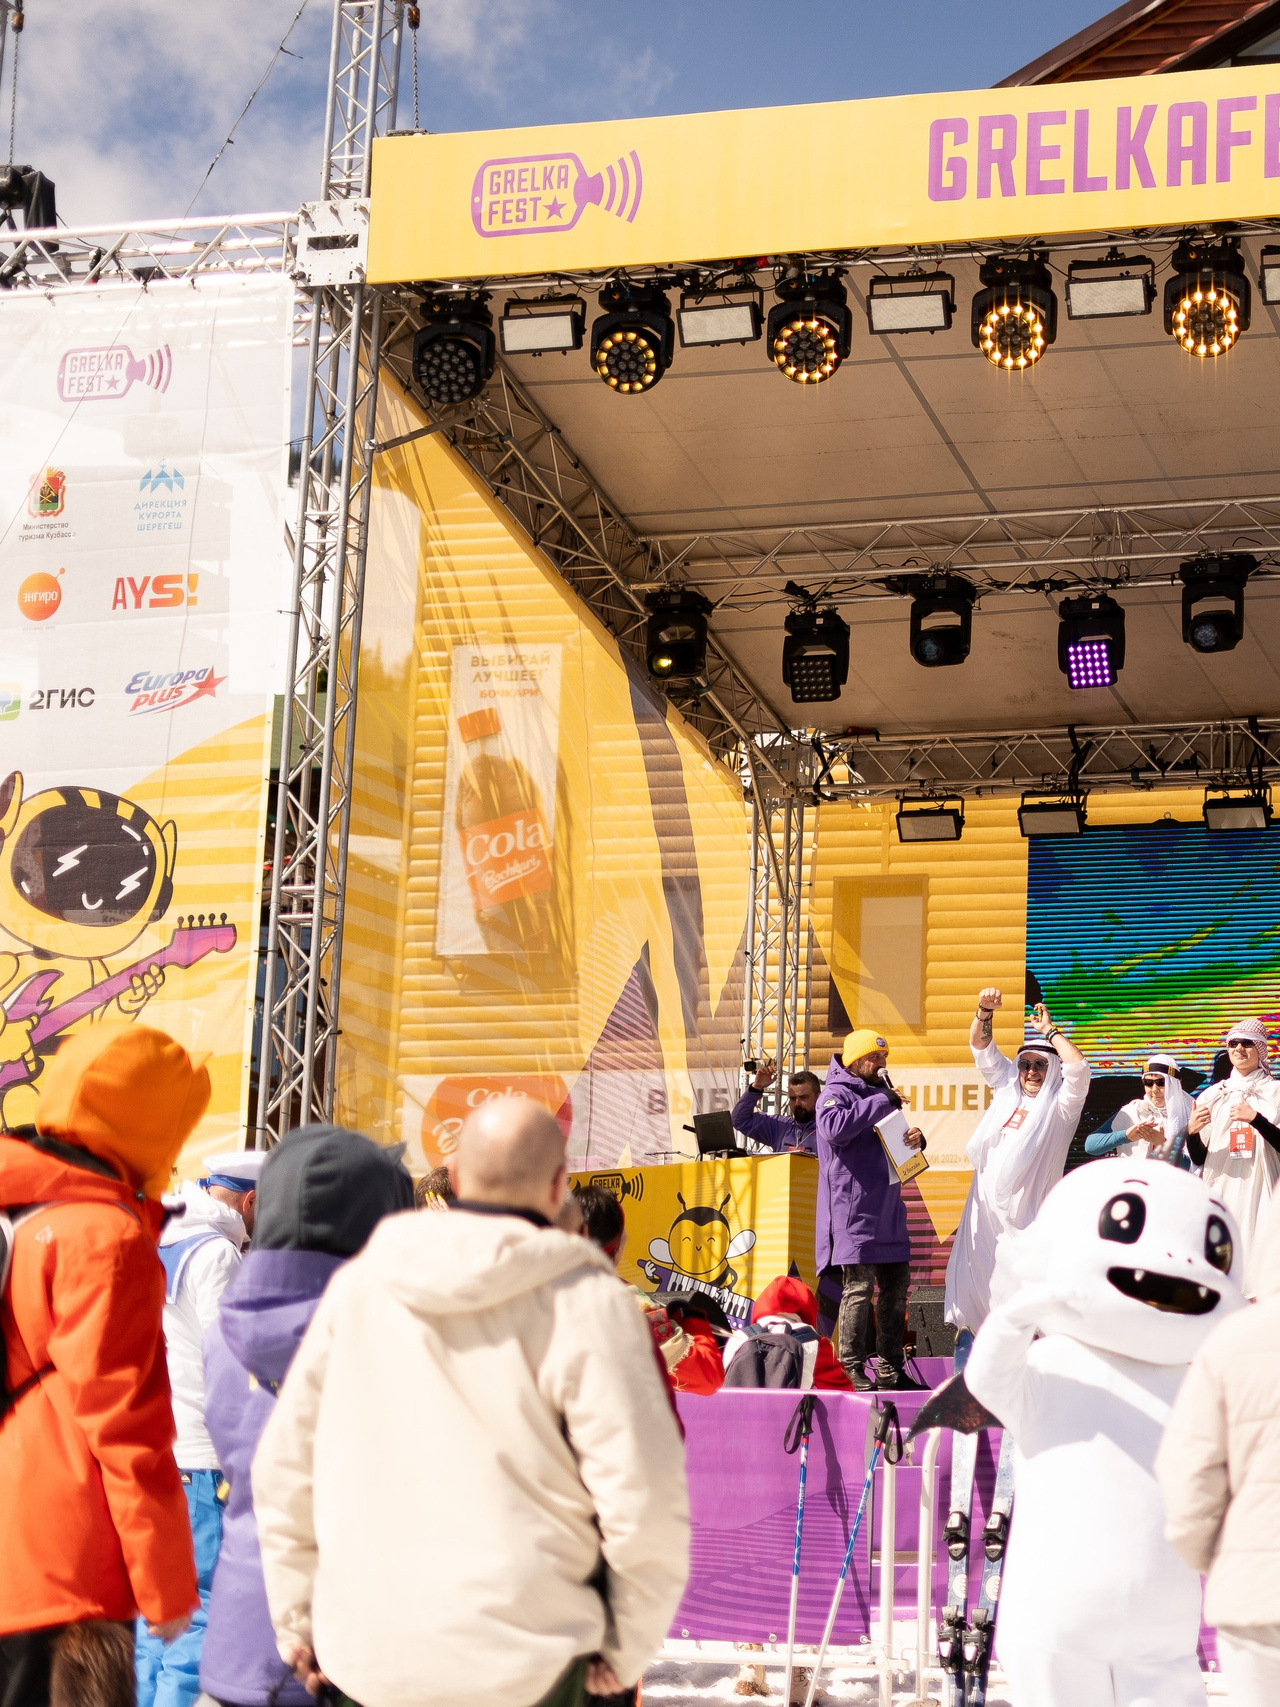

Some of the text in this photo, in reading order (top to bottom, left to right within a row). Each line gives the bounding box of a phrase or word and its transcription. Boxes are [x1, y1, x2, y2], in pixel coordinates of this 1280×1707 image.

[488, 164, 570, 196] GRELKA
[487, 196, 543, 226] FEST
[69, 353, 124, 374] GRELKA
[67, 375, 105, 395] FEST
[134, 500, 188, 511] ДИРЕКЦИЯ
[22, 521, 69, 531] Министерство
[136, 521, 182, 531] ШЕРЕГЕШ
[138, 511, 182, 521] КУРОРТА
[22, 590, 58, 604] энгиро
[111, 573, 199, 611] AYS!
[471, 650, 551, 668] ВЫБИРАЙ
[29, 687, 96, 711] 2ГИС
[466, 819, 554, 867] Cola
